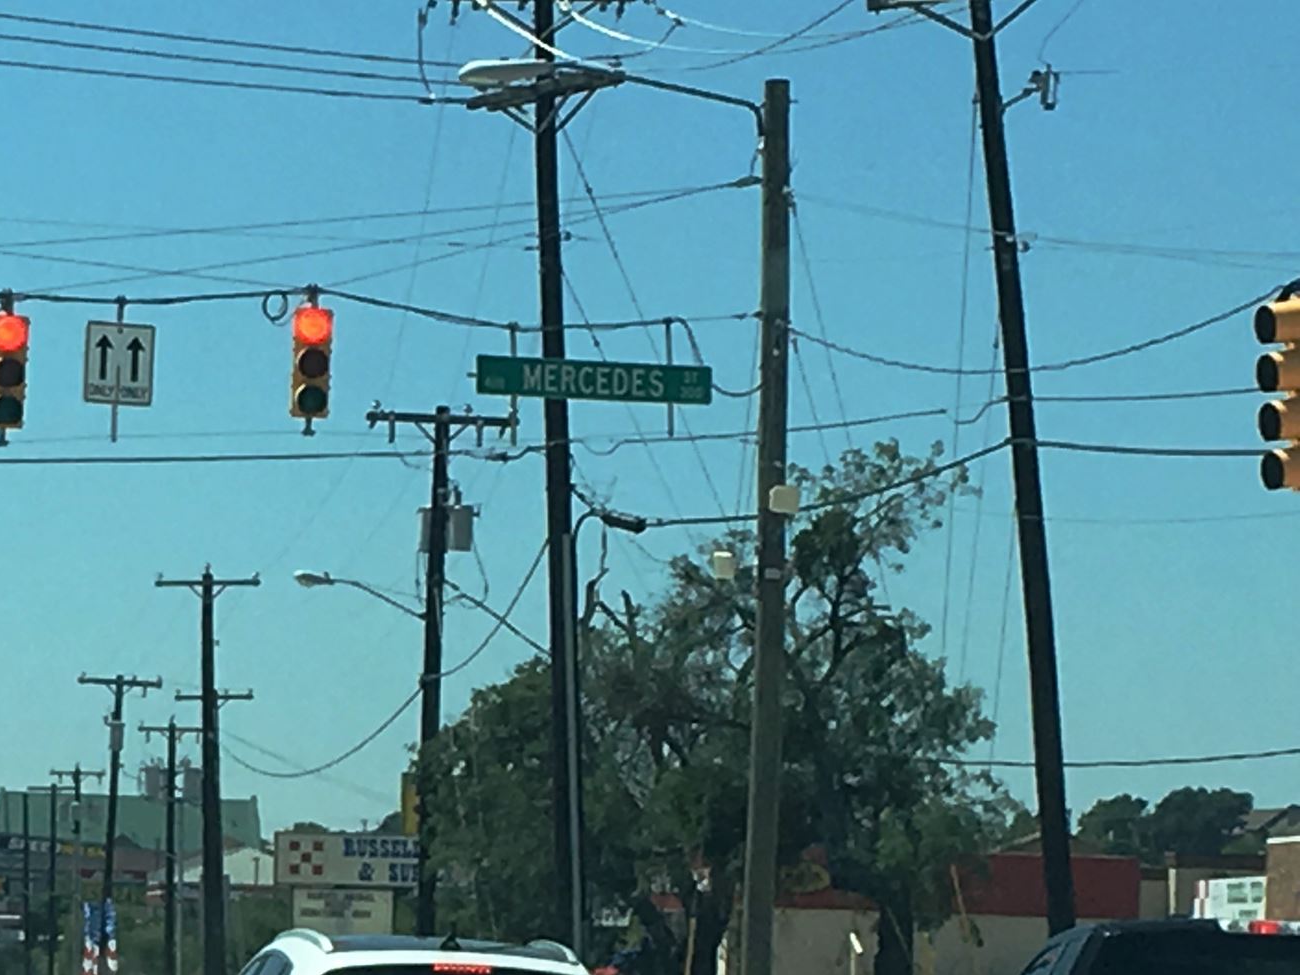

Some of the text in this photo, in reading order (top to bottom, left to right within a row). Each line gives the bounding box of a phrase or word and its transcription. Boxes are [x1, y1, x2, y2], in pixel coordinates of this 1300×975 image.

[523, 363, 699, 398] MERCEDES ST
[358, 861, 374, 881] &
